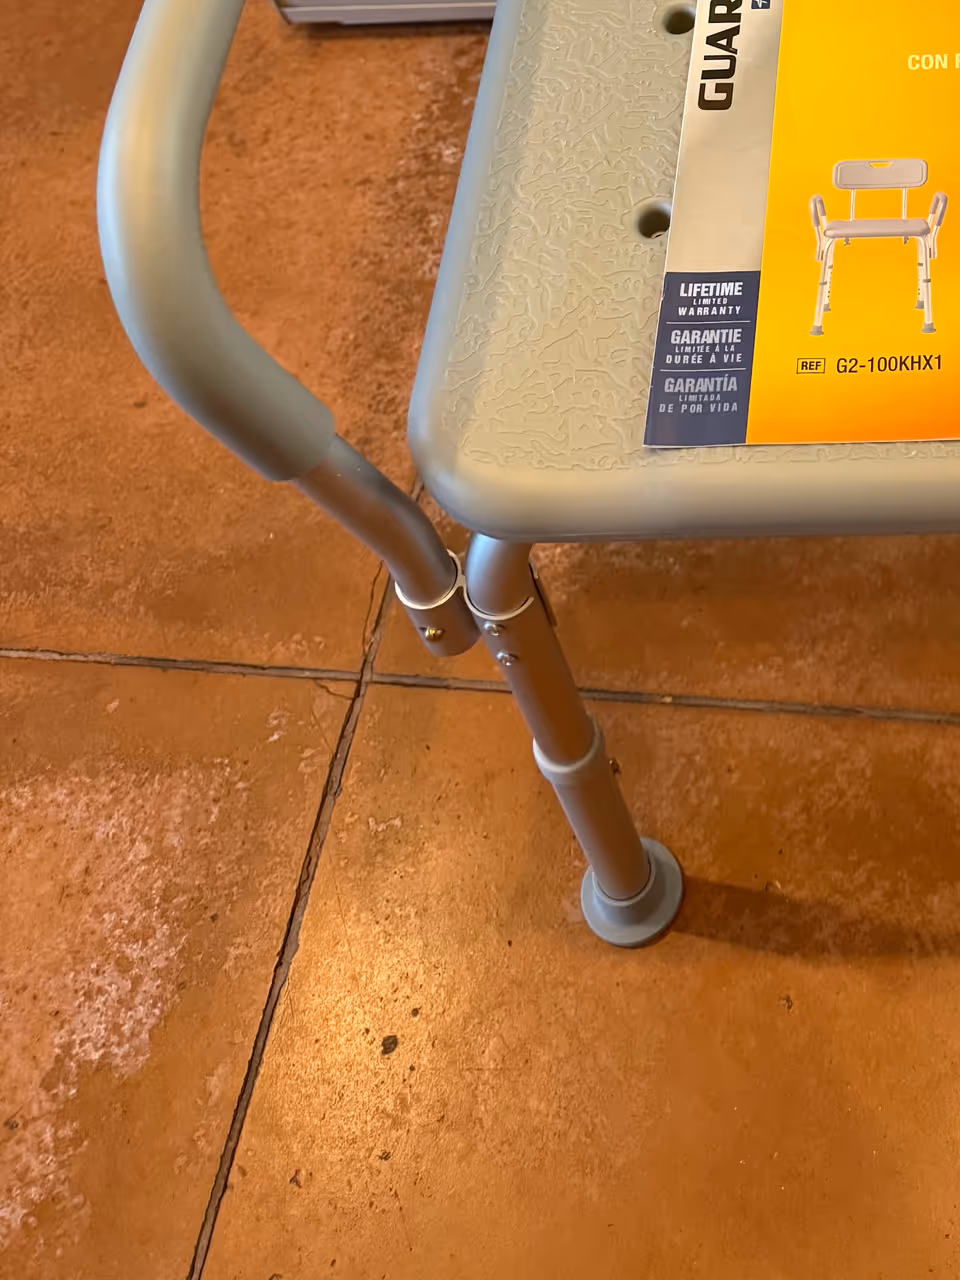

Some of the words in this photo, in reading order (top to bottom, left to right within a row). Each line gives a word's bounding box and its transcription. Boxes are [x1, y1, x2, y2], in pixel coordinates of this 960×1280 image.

[907, 53, 948, 70] CON
[680, 282, 743, 297] LIFETIME
[678, 306, 741, 316] WARRANTY
[670, 328, 742, 344] GARANTIE
[675, 345, 710, 353] LIMITÉE
[665, 354, 703, 364] DURÉE
[710, 353, 716, 364] À
[724, 353, 742, 363] VIE
[801, 360, 822, 371] REF
[836, 354, 942, 373] G2-100KHX1
[664, 374, 738, 393] GARANTÍA
[679, 394, 721, 402] LIMITADA
[659, 404, 674, 413] DE
[681, 404, 703, 413] POR
[710, 402, 738, 412] VIDA
